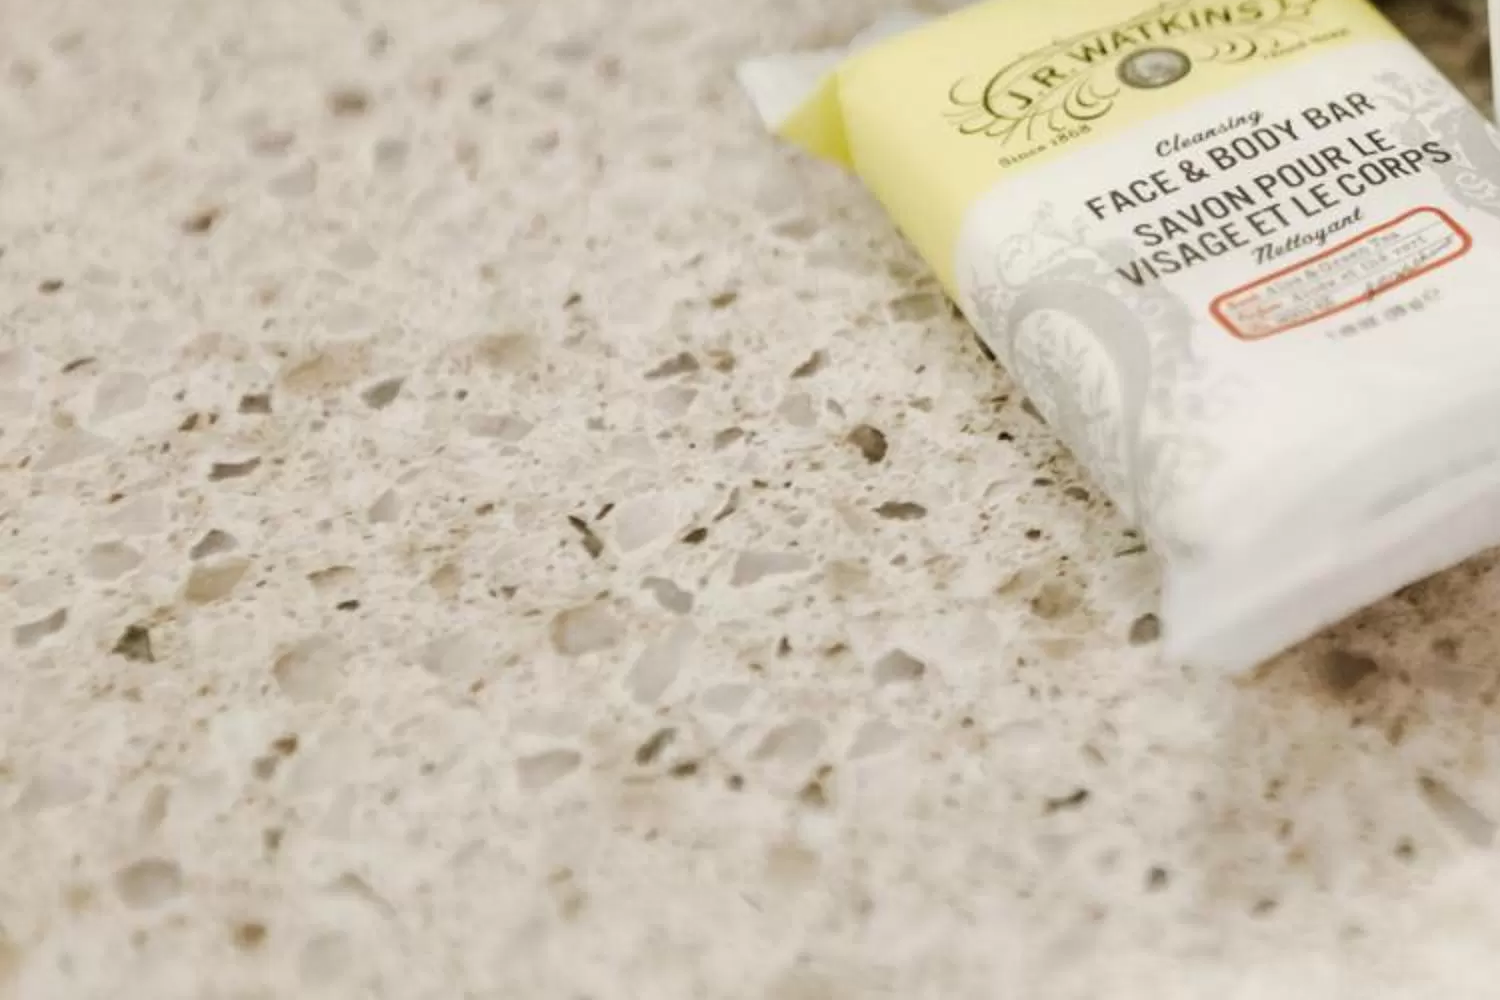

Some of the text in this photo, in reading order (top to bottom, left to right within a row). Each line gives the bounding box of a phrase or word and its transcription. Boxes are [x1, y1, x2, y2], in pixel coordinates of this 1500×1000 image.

[1068, 1, 1264, 63] WATKINS
[1085, 91, 1376, 220] FACE & BODY BAR
[1155, 107, 1264, 158] Cleansing
[1116, 141, 1453, 288] VISAGE ET LE CORPS
[1133, 129, 1397, 248] SAVON POUR LE
[1250, 206, 1364, 266] Nettoyant
